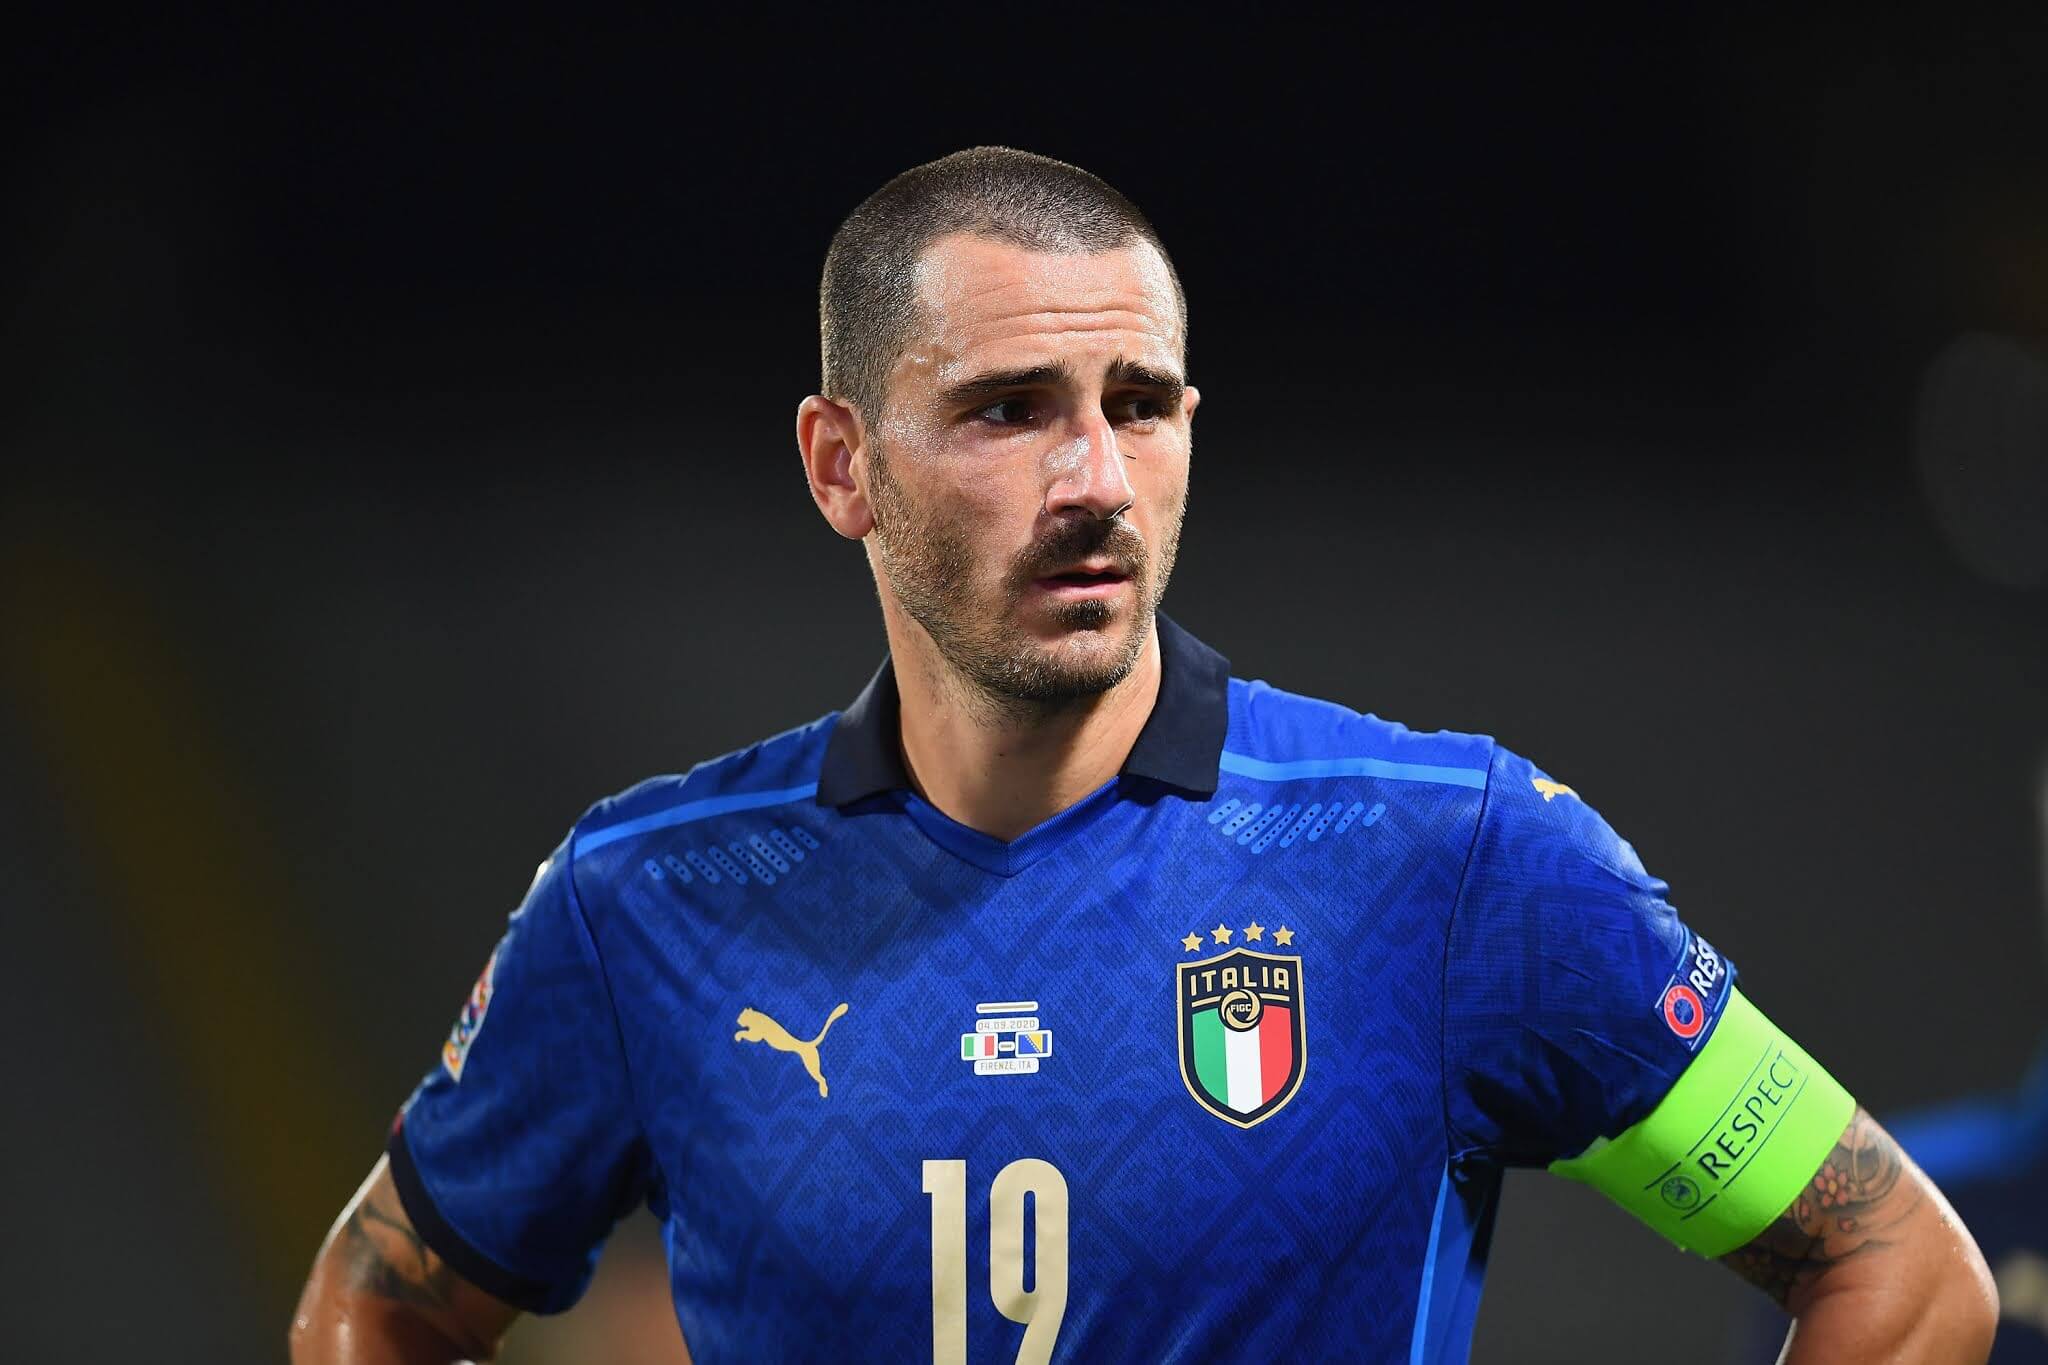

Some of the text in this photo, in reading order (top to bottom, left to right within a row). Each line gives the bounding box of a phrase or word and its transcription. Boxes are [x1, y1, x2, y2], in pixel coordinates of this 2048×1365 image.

[1190, 966, 1290, 996] ITALIA
[1231, 1004, 1251, 1013] FIGC
[1018, 1060, 1032, 1069] ITA
[1698, 1050, 1798, 1179] RESPECT
[922, 1158, 1069, 1365] 19
